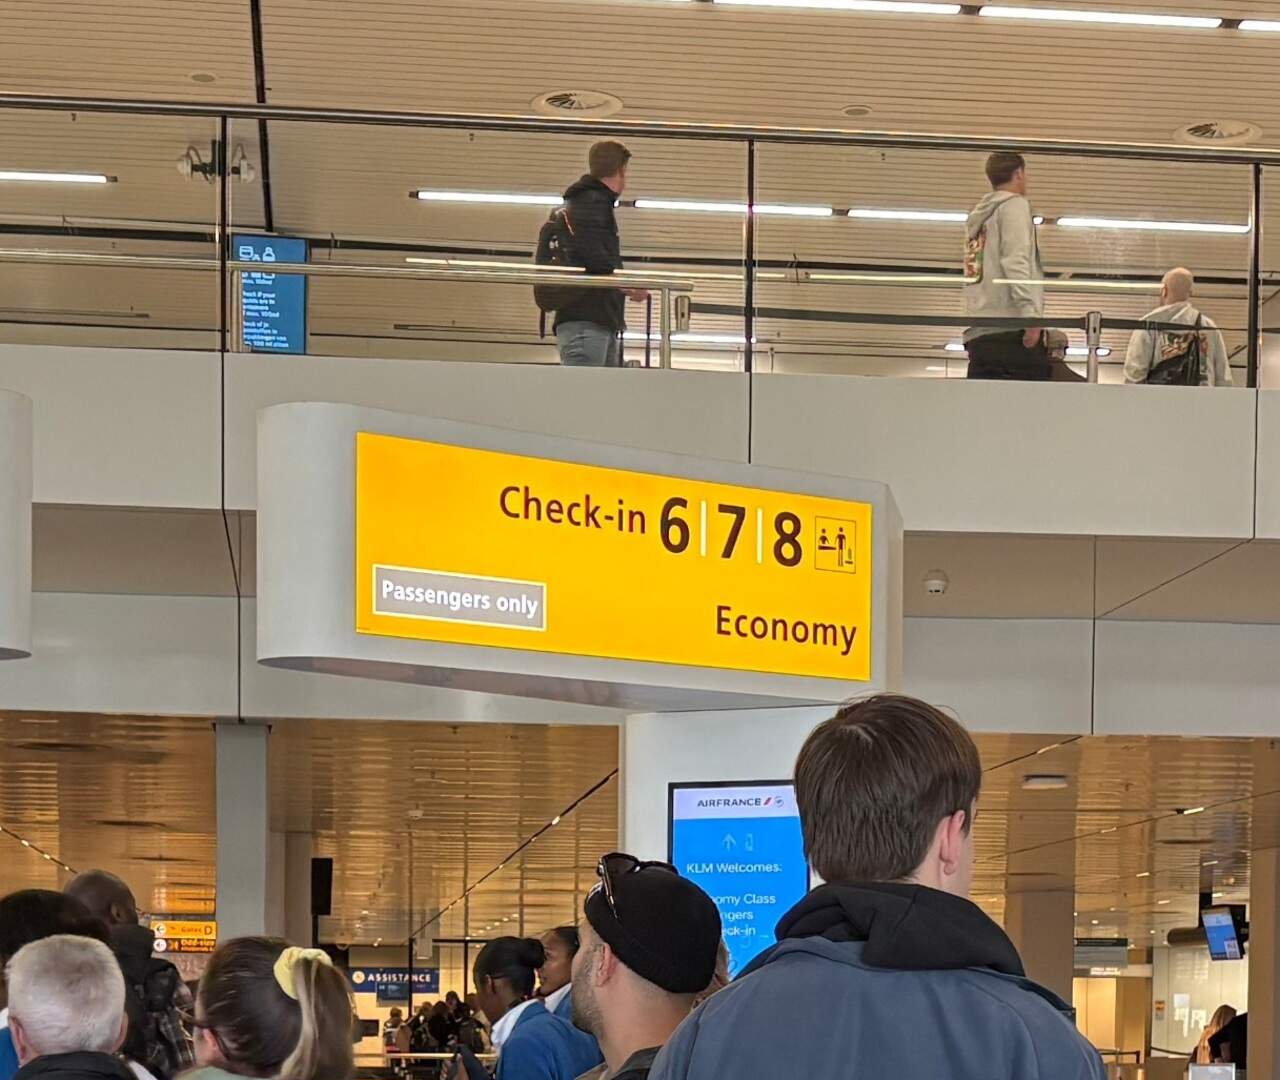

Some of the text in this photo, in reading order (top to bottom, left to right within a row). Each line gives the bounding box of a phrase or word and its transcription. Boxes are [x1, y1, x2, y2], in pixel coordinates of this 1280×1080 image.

[500, 487, 803, 567] Check-in 6 7 8
[382, 580, 538, 619] Passengers only
[717, 606, 857, 655] Economy
[697, 798, 761, 807] AIRFRANCE
[687, 862, 783, 874] KLM Welcomes:
[743, 893, 777, 904] Class
[204, 926, 213, 936] D
[367, 973, 431, 982] ASSISTANCE
